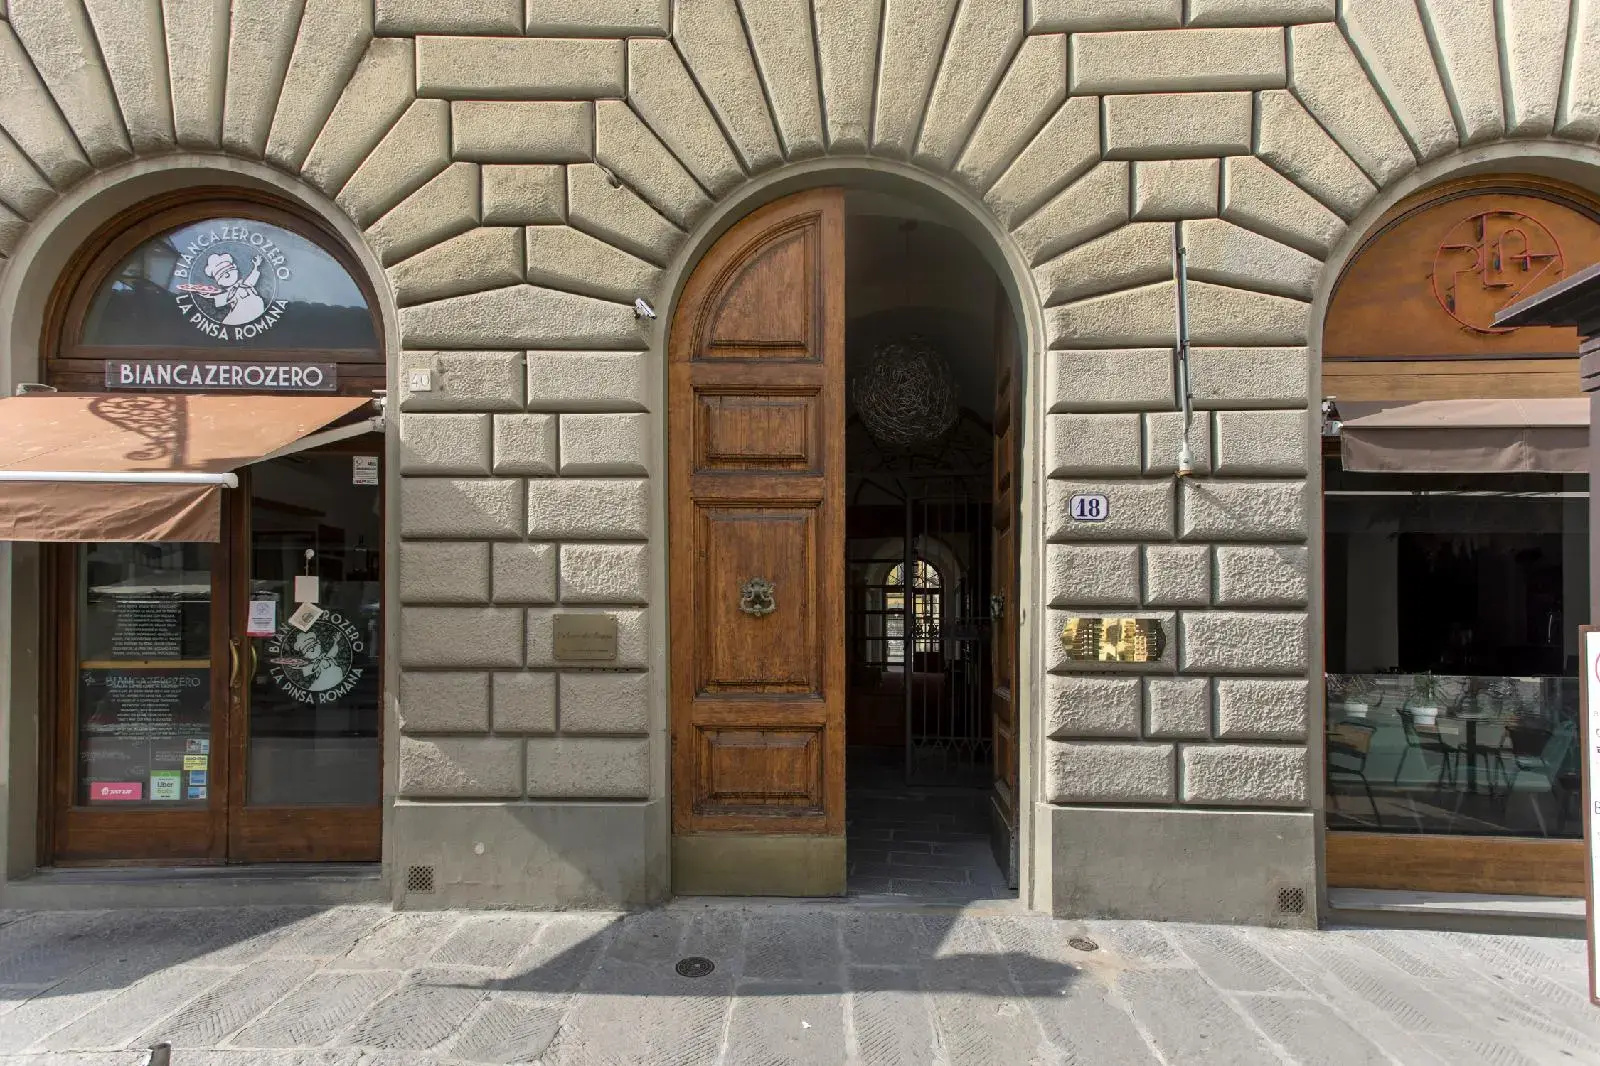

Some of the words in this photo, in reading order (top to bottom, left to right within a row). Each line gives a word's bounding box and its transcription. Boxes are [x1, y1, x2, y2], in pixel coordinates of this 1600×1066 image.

[174, 226, 290, 280] BIANCAZEROZERO
[176, 294, 193, 315] LA
[190, 312, 229, 341] PINSA
[234, 299, 289, 341] ROMANA
[120, 363, 324, 387] BIANCAZEROZERO
[411, 373, 430, 388] 40
[1076, 498, 1101, 518] 18
[268, 609, 364, 654] BIANROZERO
[270, 667, 285, 685] LA
[281, 681, 315, 705] PINSA
[319, 668, 364, 704] ROMANA
